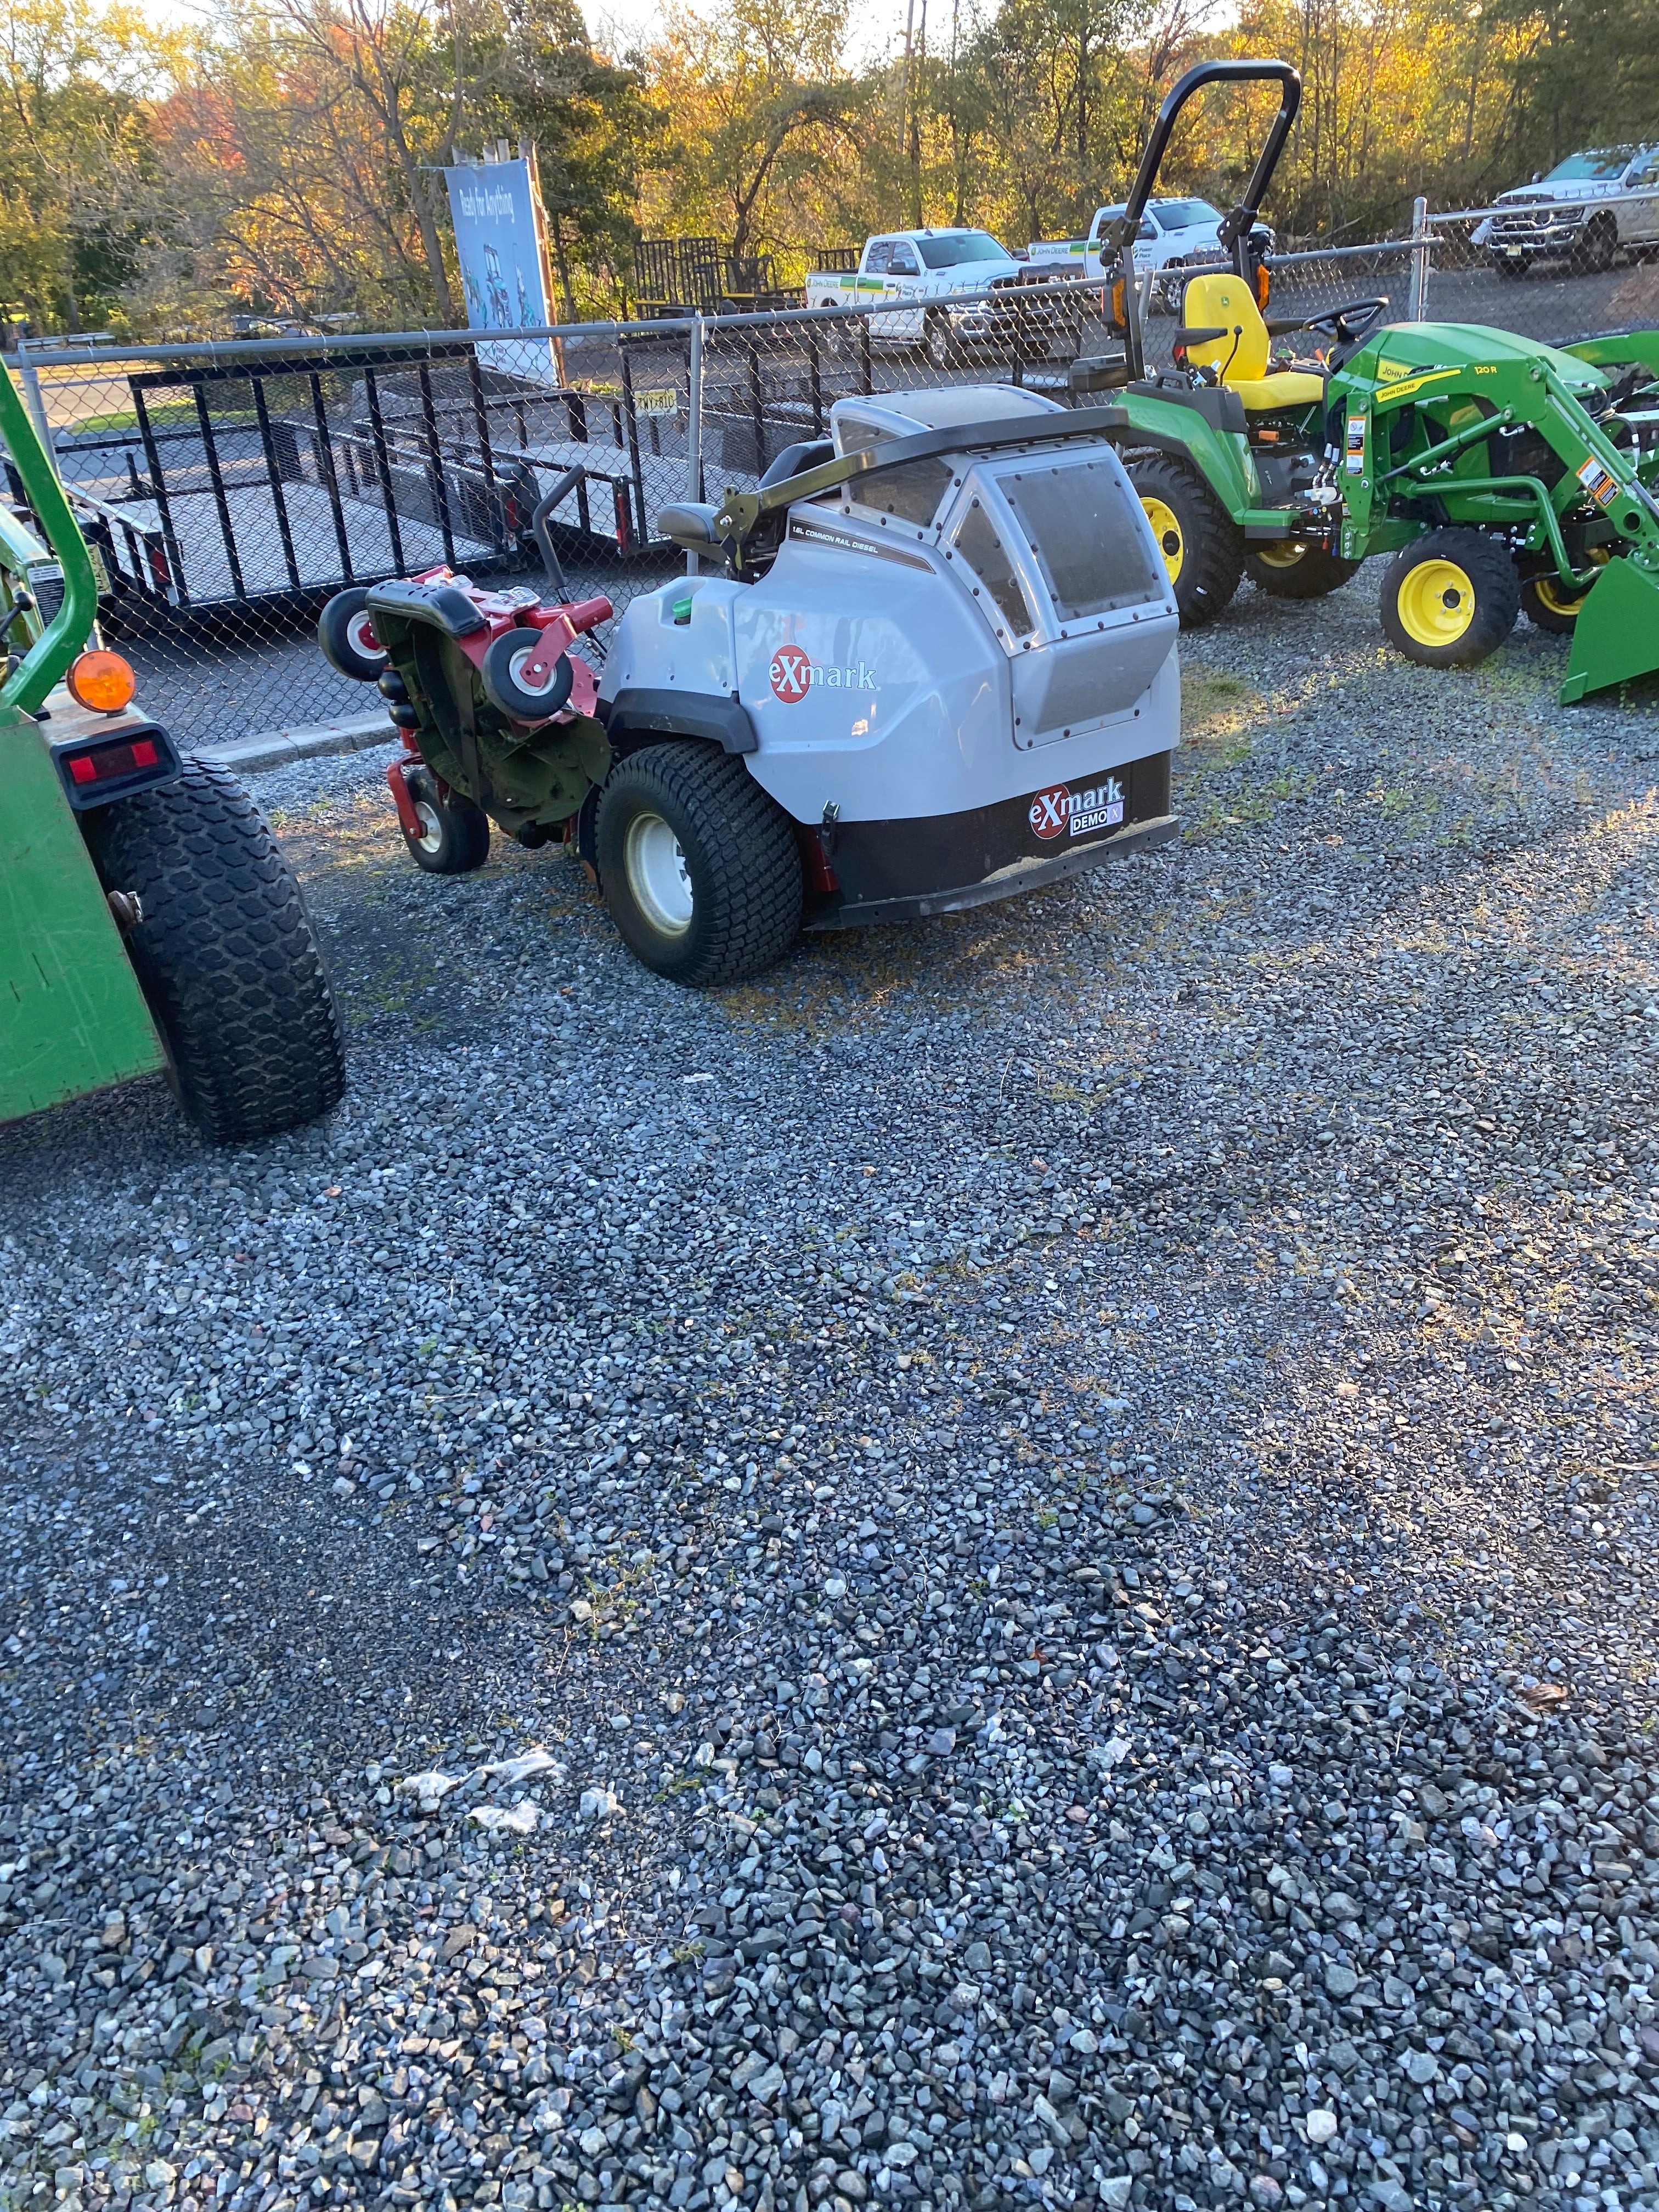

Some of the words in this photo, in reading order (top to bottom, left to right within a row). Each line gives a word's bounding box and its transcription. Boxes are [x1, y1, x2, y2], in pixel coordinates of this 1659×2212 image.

[459, 187, 478, 225] Ready
[475, 187, 486, 216] for
[484, 184, 515, 224] Anything
[812, 278, 823, 287] JOHN
[823, 279, 839, 289] DEERE
[1383, 366, 1402, 379] JOHN
[1474, 366, 1489, 375] 120
[1381, 390, 1396, 398] JOHN
[1396, 383, 1415, 393] DEERE
[805, 529, 834, 543] COMMON
[834, 537, 850, 546] RAIL
[852, 541, 878, 554] DIESEL
[769, 655, 877, 693] eXmark
[1029, 776, 1123, 831] eXmark
[1074, 810, 1107, 832] DEMO
